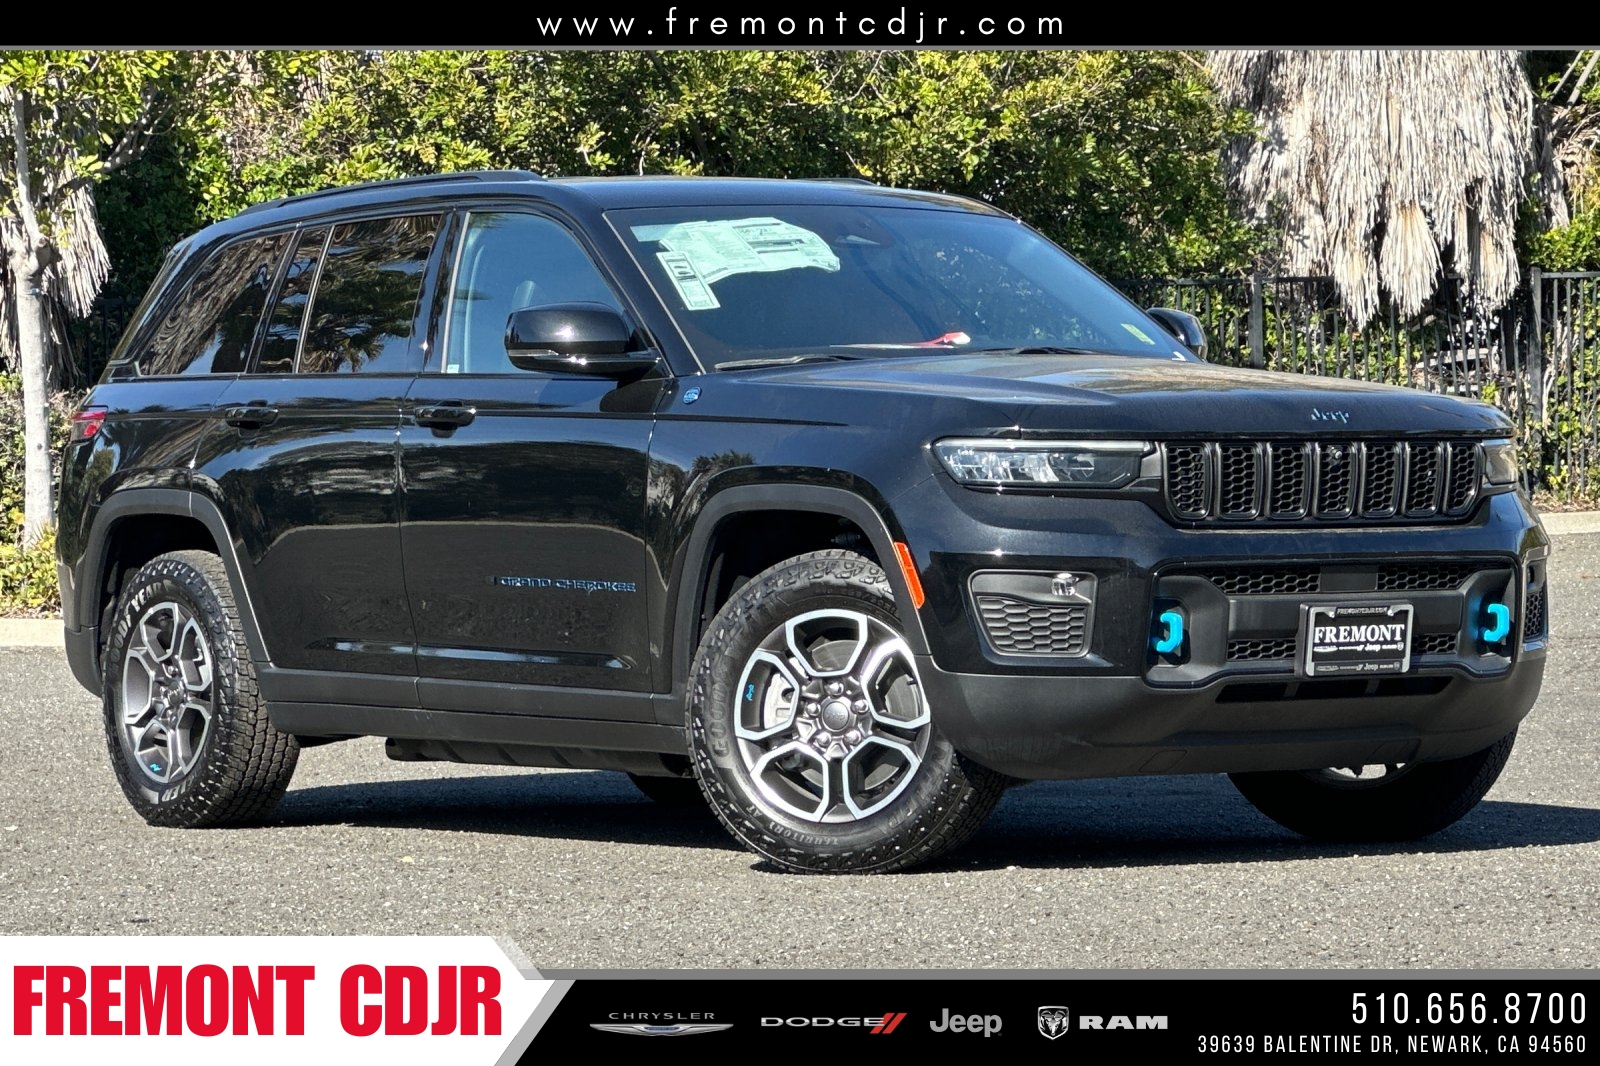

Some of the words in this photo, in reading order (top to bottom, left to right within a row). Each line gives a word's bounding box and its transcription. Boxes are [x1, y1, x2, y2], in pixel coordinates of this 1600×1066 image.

[500, 576, 551, 588] GRAND
[555, 579, 636, 592] CHEROKEE
[1314, 624, 1405, 643] FREMONT
